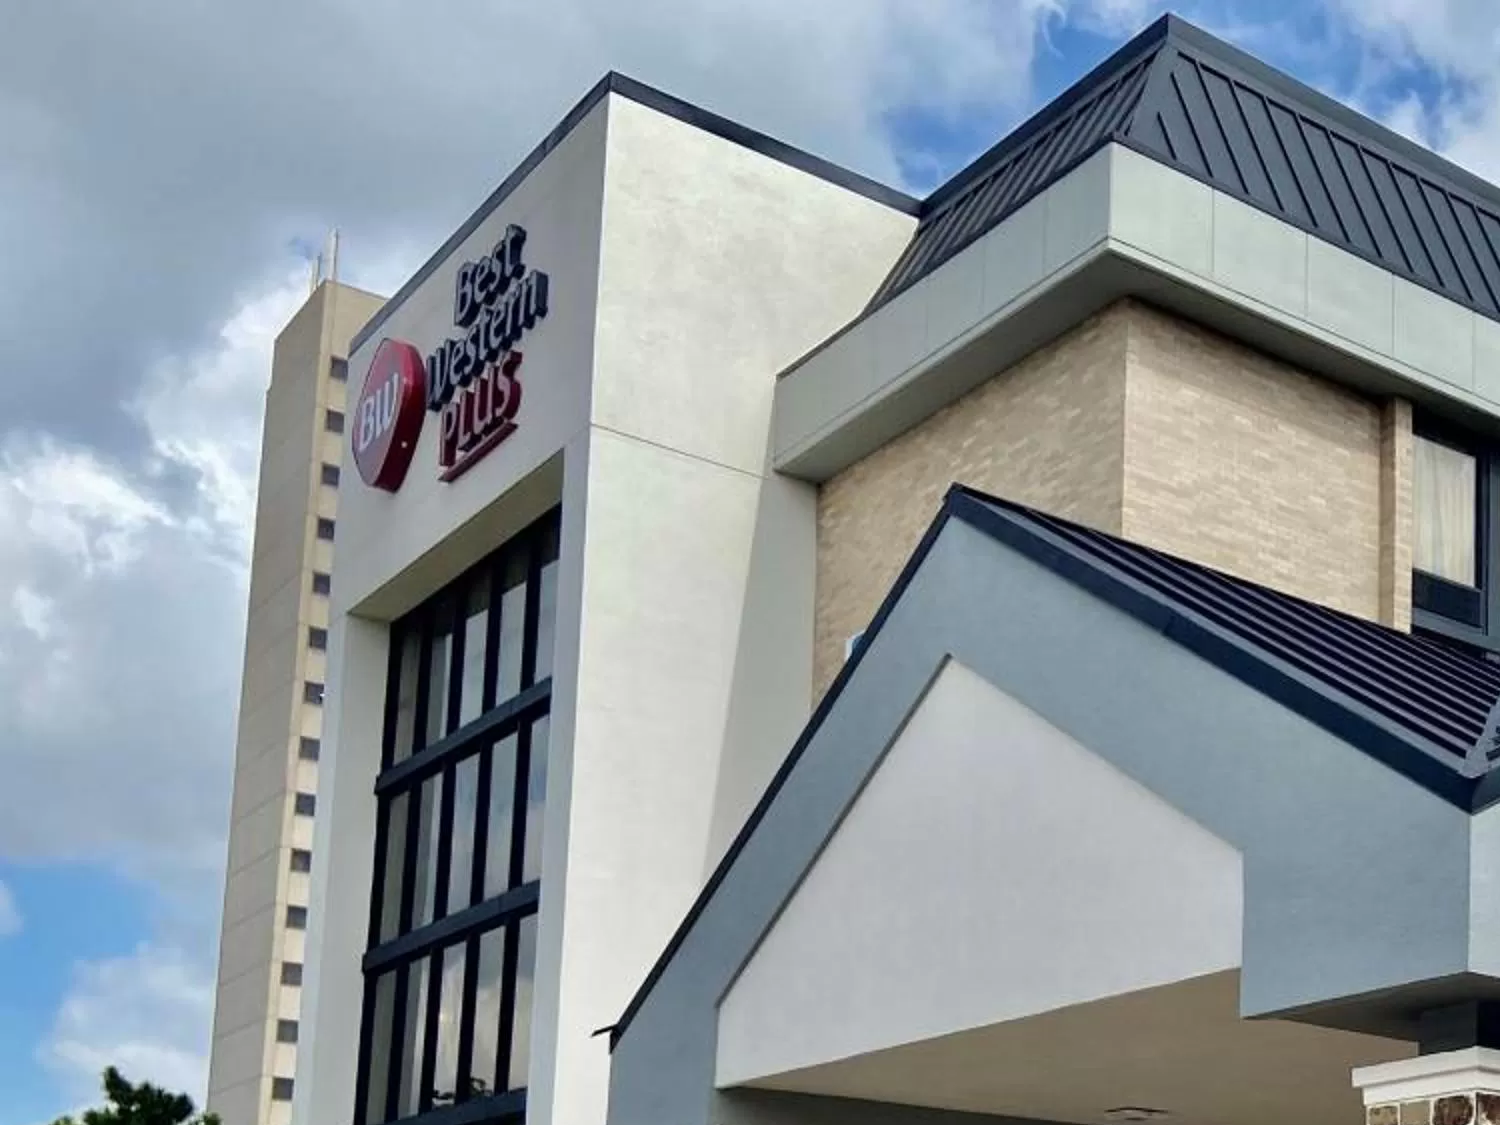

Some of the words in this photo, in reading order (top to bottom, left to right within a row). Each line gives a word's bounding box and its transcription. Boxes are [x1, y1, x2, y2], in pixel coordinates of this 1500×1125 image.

[454, 224, 527, 327] Best
[426, 270, 549, 412] Western
[358, 373, 400, 452] BW
[440, 350, 523, 467] PLUS
